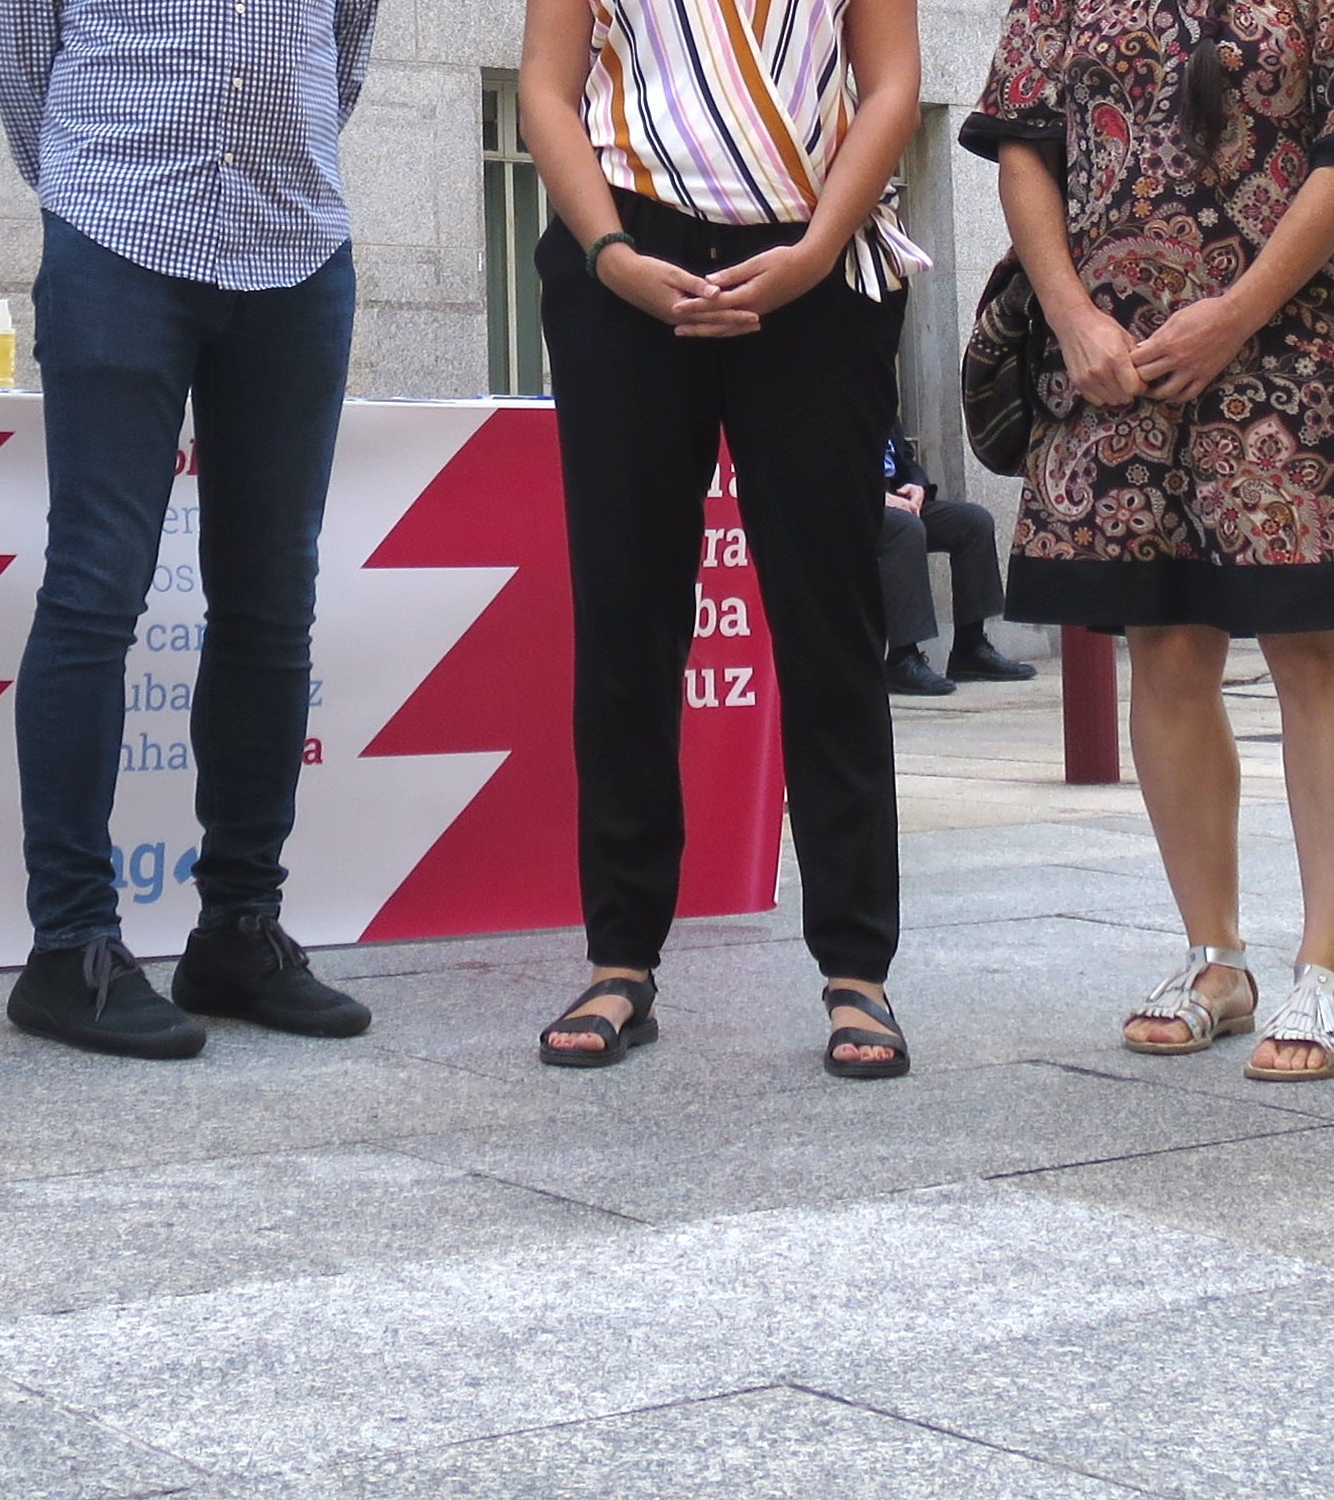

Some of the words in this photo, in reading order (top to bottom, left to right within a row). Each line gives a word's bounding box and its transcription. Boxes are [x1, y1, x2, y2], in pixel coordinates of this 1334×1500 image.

[693, 583, 751, 638] ba
[146, 622, 206, 652] car
[124, 673, 191, 712] uba
[684, 667, 756, 709] uz
[119, 733, 188, 772] nha
